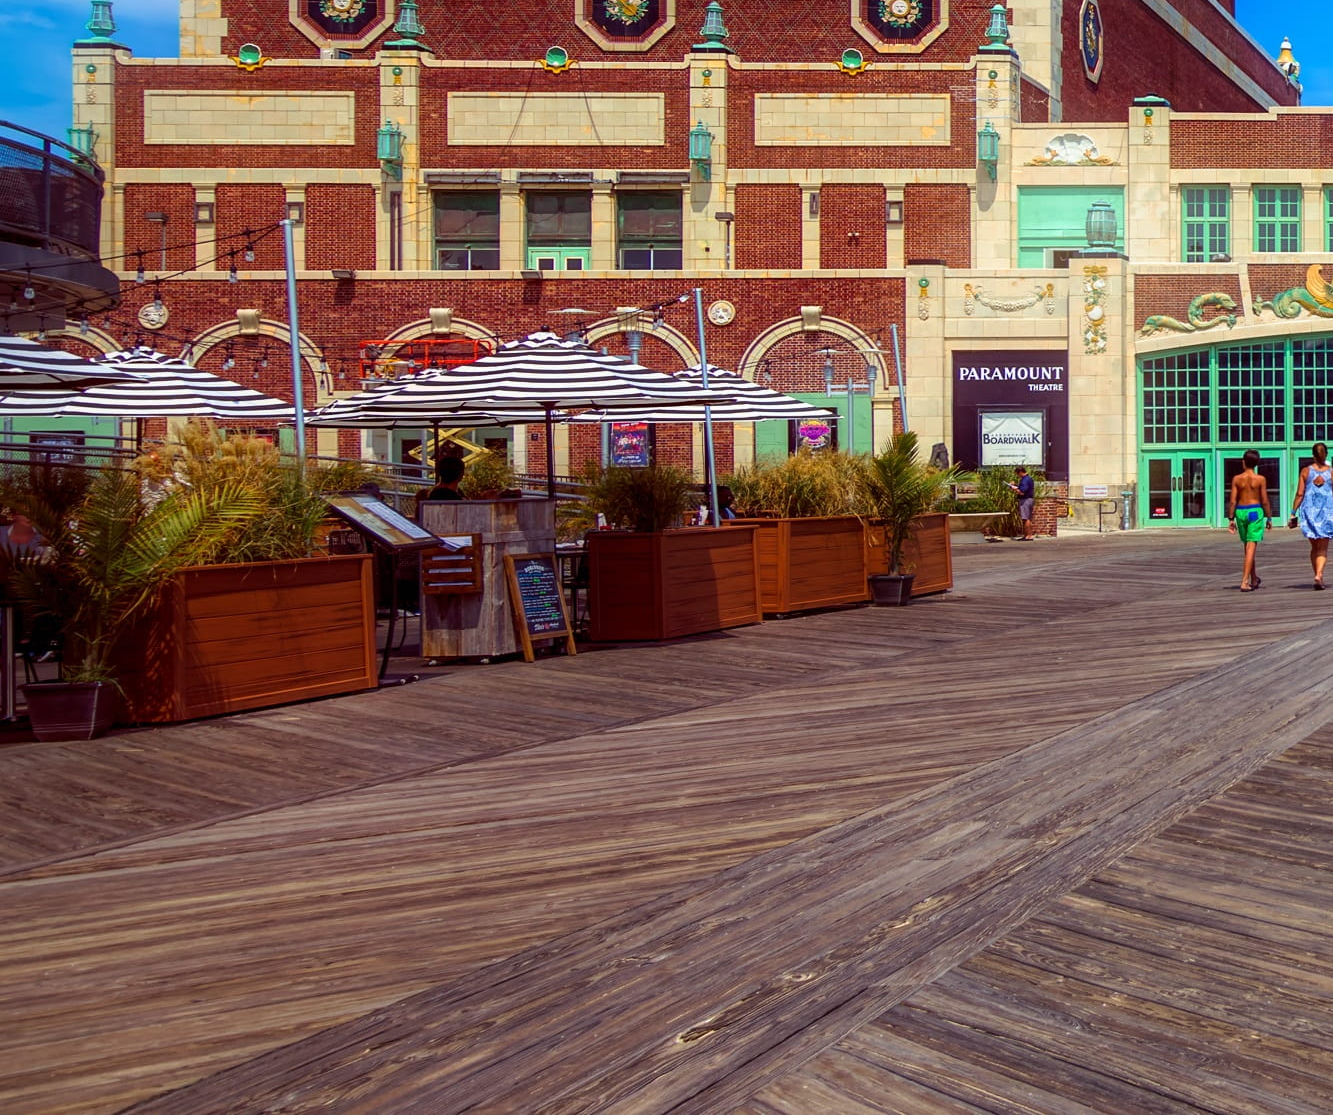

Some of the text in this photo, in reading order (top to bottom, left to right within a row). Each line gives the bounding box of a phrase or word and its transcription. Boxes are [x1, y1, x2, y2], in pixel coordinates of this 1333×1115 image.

[960, 367, 1064, 381] PARAMOUNT
[1028, 383, 1064, 391] THEATRE
[983, 433, 1041, 445] BOARDWALK
